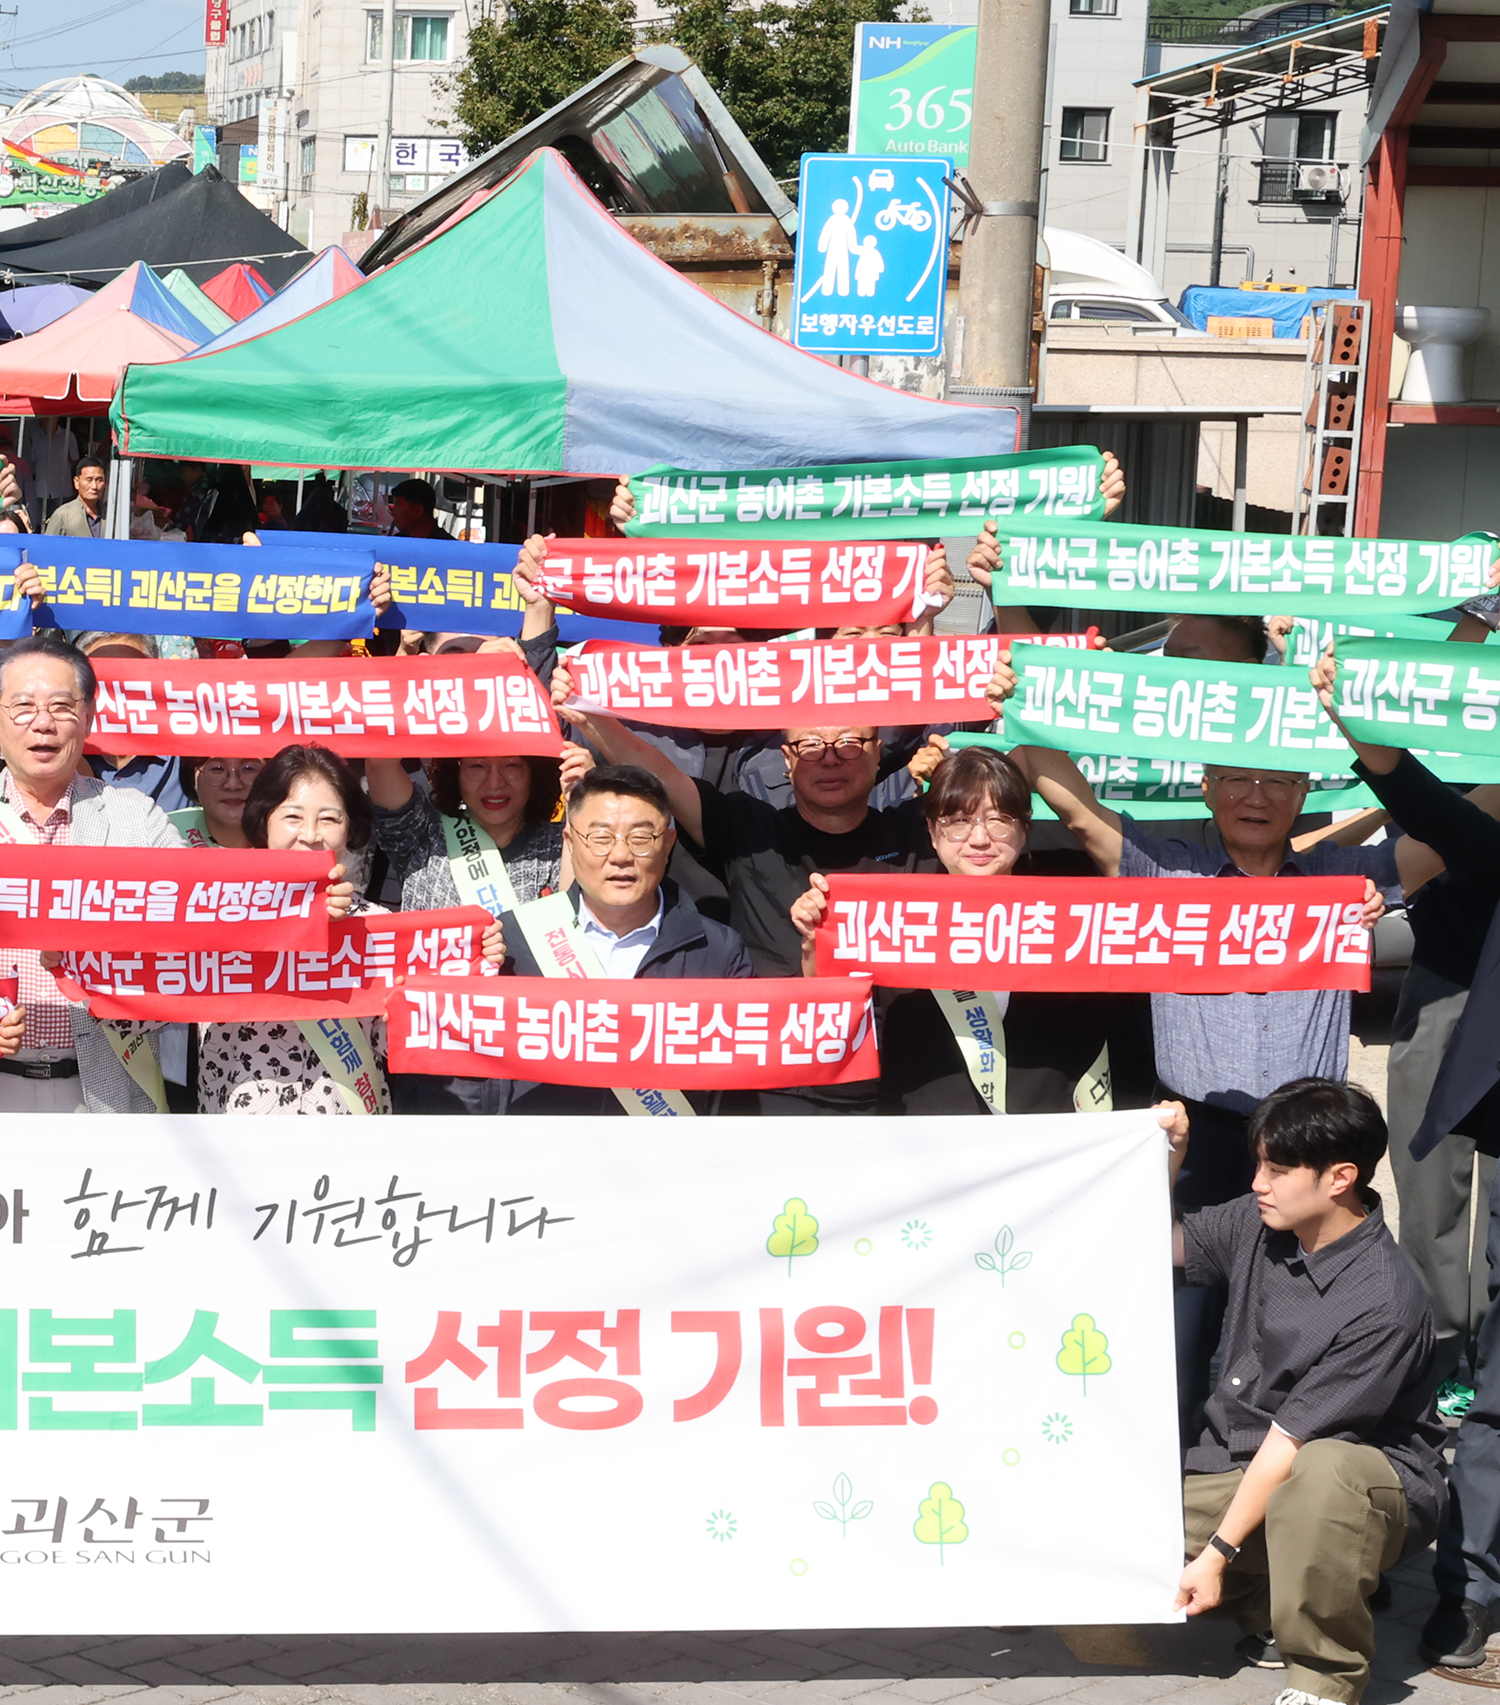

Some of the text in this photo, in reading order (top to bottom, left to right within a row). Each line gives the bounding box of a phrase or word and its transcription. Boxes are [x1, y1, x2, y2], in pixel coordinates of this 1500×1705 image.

[868, 36, 902, 49] NH
[884, 85, 973, 133] 365
[885, 139, 969, 154] Auto Bank
[19, 173, 116, 197] 괴산전통
[800, 314, 934, 337] 보행자우선도로
[640, 466, 1097, 525] 괴산군 농어촌 기본소득 선정 기원!
[31, 566, 361, 614] 본소득! 괴산군을 선정한다
[382, 566, 482, 608] 본소득!
[582, 553, 676, 604] 농어촌
[687, 546, 810, 606] 기본소득
[821, 546, 885, 604] 선정
[1007, 537, 1492, 597] 괴산군 농어촌 기본소득 선정 기원!
[579, 639, 998, 708] 괴산군 농어촌 기본소득 선정
[1338, 659, 1455, 726] 괴산군
[90, 676, 551, 736] 산군 농어촌 기본소득 선정 기원!
[1023, 666, 1124, 733] 괴산군
[1132, 674, 1238, 743] 농어촌
[49, 879, 178, 922] 괴산군을
[184, 882, 314, 923] 선정한다
[833, 900, 937, 964] 괴산군
[949, 903, 1054, 964] 농어촌
[1066, 902, 1211, 965] 기본소득
[1218, 903, 1295, 965] 선정
[404, 990, 506, 1058] 괴산군
[516, 997, 618, 1064] 농어촌
[629, 1001, 769, 1066] 기본소득
[780, 999, 850, 1065] 선정
[965, 1006, 995, 1073] 생활화
[63, 1167, 217, 1259] 함께
[254, 1174, 576, 1267] 기원합니다
[405, 1309, 643, 1430] 선정
[670, 1305, 938, 1427] 기원!
[1, 1496, 214, 1543] 괴산군
[0, 1548, 212, 1565] GOE SAN GUN
